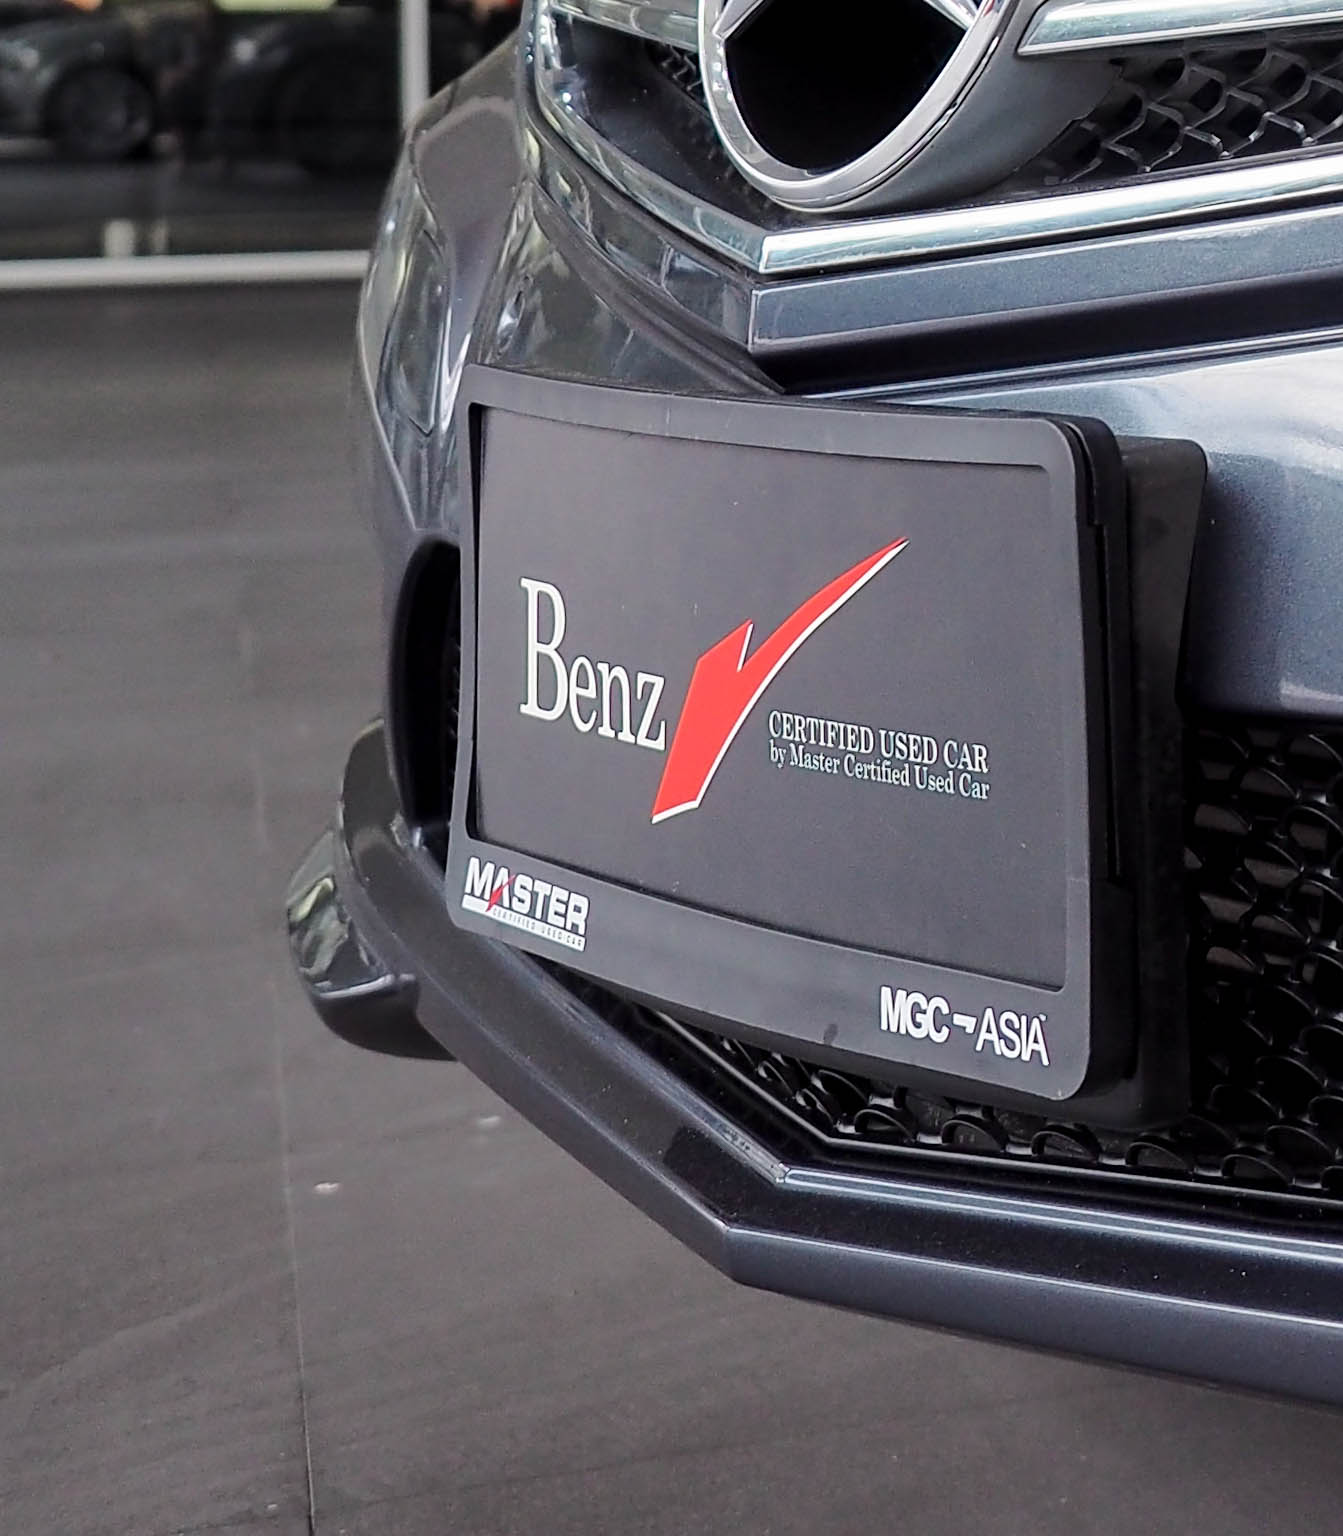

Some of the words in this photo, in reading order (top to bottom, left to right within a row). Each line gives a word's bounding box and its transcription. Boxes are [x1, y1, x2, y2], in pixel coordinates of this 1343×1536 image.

[519, 576, 667, 751] Benz
[768, 710, 874, 755] CERTIFIED
[879, 729, 938, 765] USED
[943, 740, 989, 774] CAR
[768, 739, 787, 769] by
[789, 742, 840, 775] Master
[843, 754, 911, 788] Certified
[915, 766, 955, 795] Used
[958, 772, 991, 801] Car
[464, 856, 590, 935] MASTER
